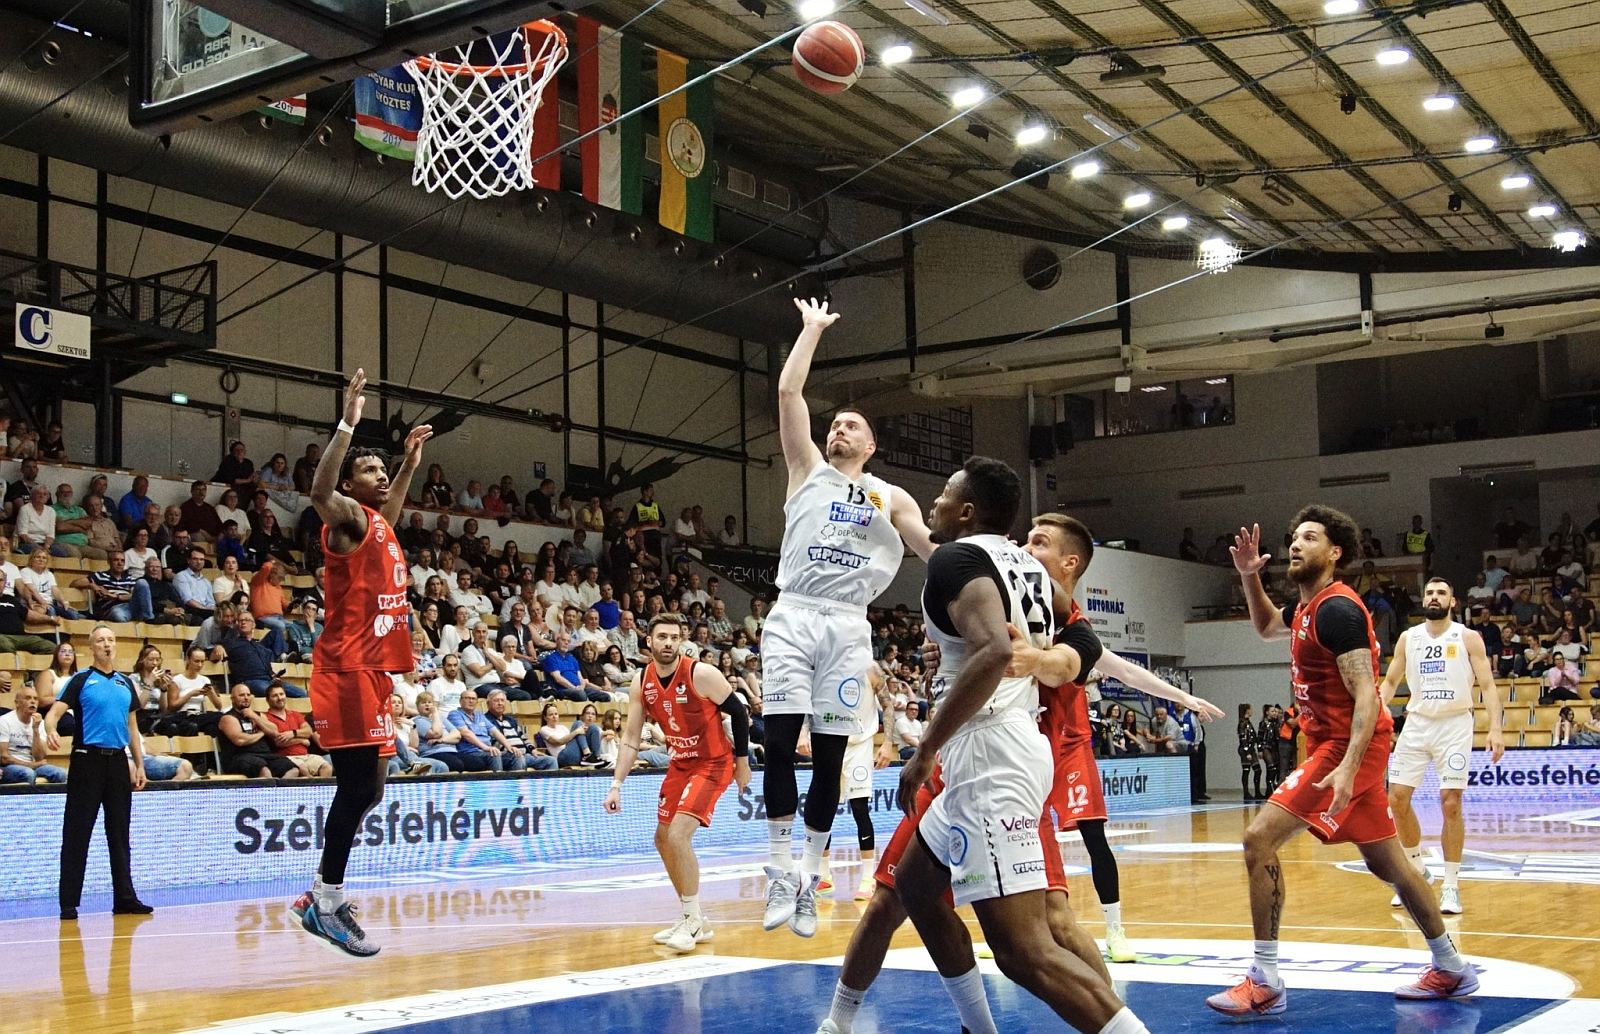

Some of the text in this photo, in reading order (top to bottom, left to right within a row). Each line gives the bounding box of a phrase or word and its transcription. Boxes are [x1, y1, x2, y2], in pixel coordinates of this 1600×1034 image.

[19, 307, 53, 350] C
[57, 344, 88, 357] SZEKTOR
[846, 483, 866, 505] 13
[1425, 645, 1443, 659] 28
[1067, 784, 1089, 809] 12
